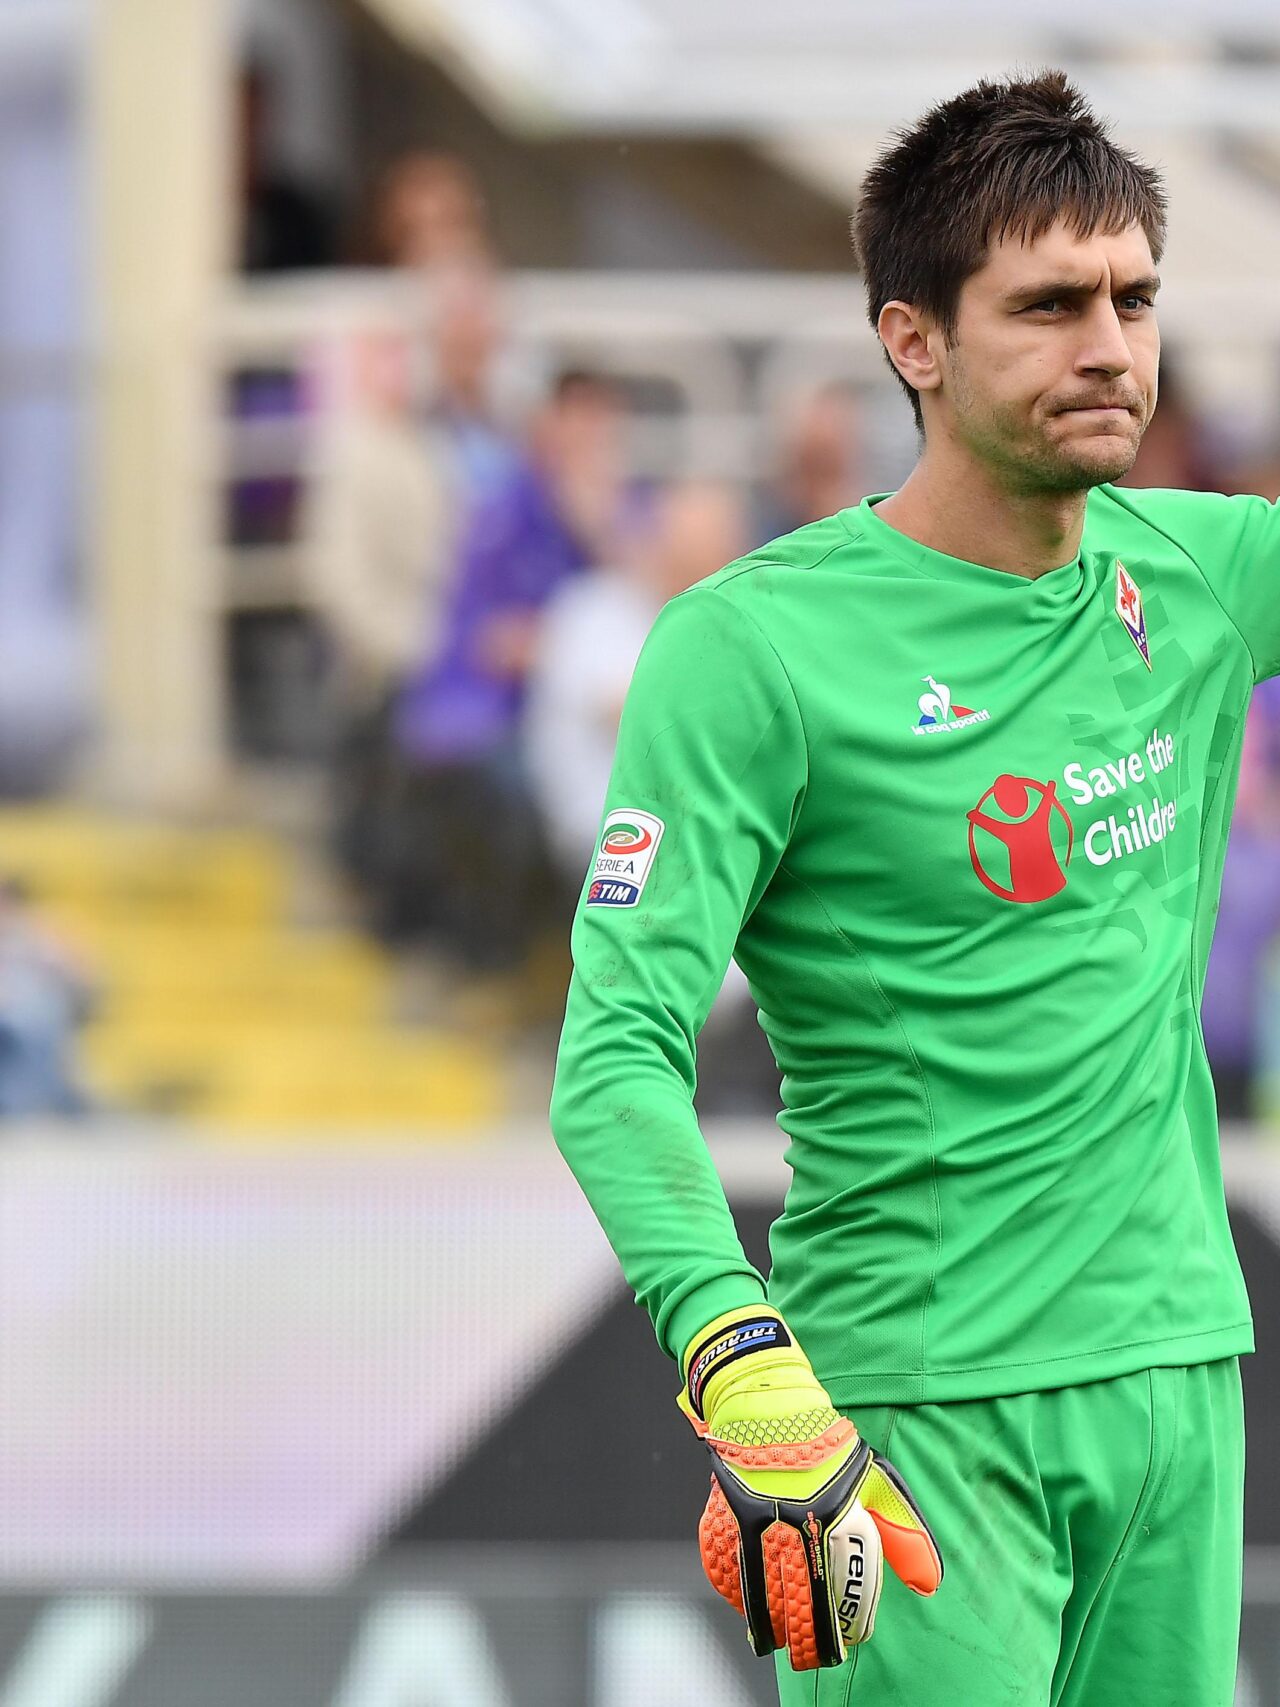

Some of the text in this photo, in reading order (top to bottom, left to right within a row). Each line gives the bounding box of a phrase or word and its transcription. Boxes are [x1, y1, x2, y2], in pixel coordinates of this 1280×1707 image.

[1063, 728, 1174, 806] Save the
[1084, 796, 1177, 866] Childre
[594, 858, 635, 875] SERIE A
[599, 884, 632, 902] TIM
